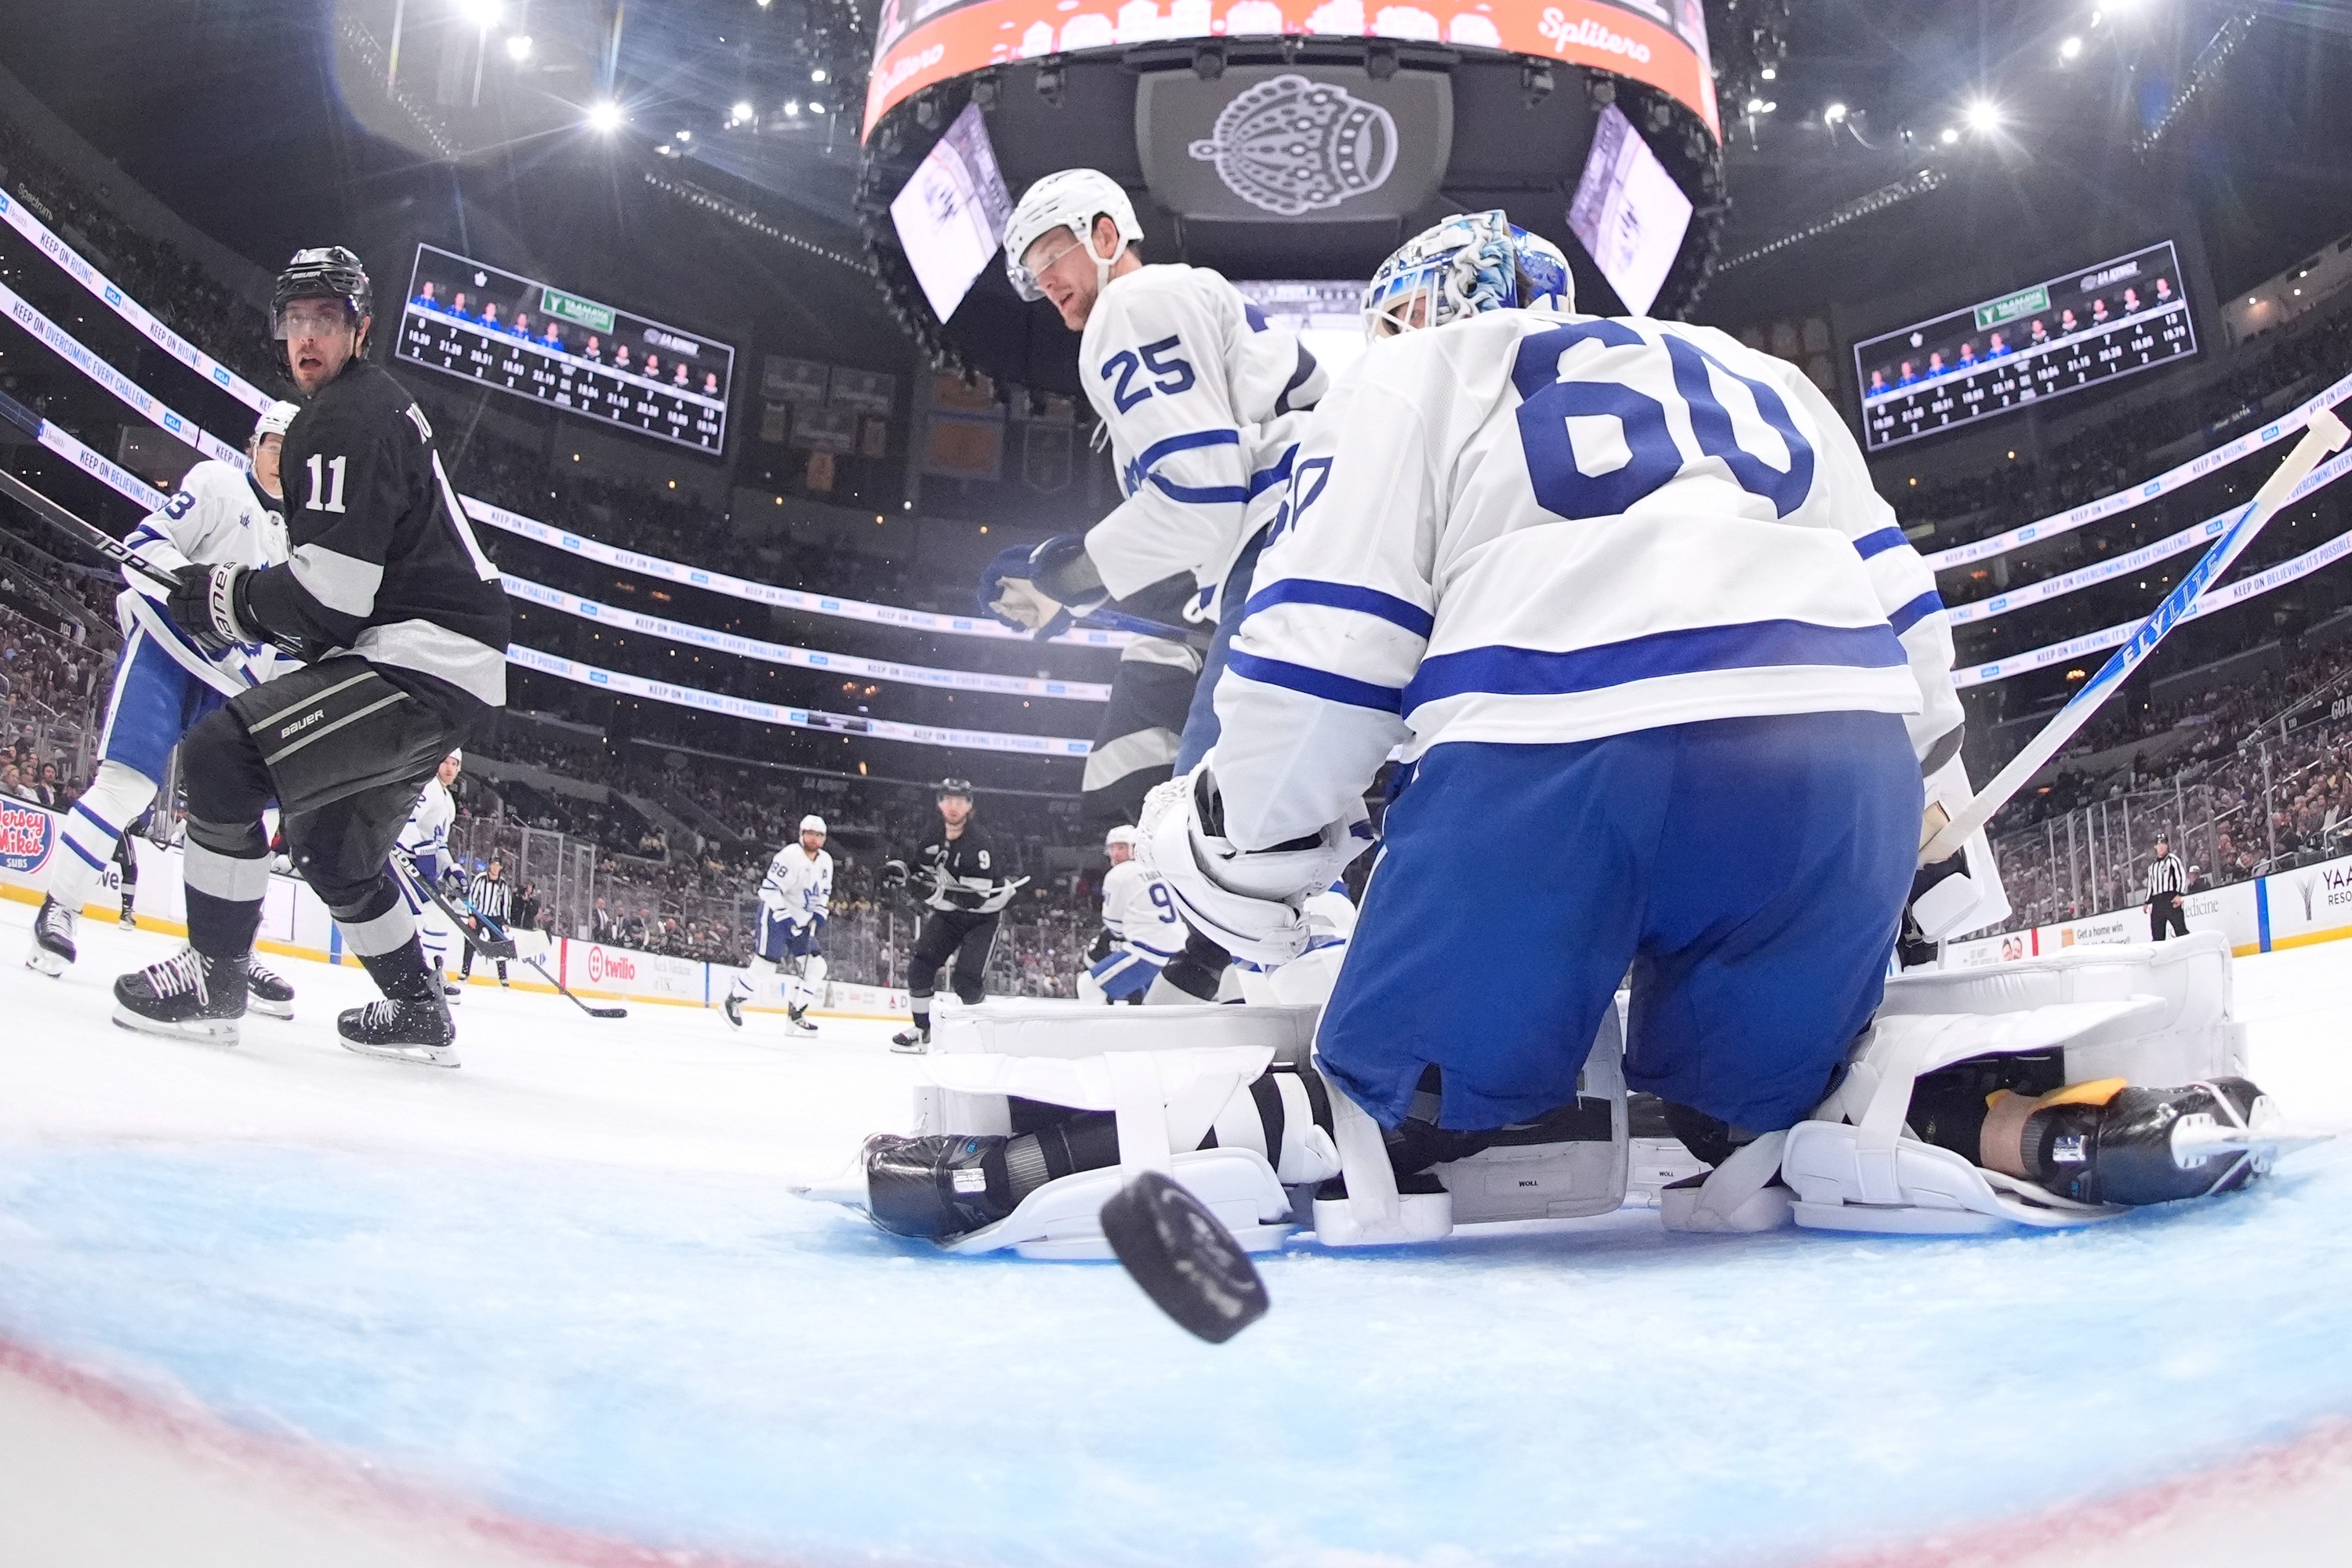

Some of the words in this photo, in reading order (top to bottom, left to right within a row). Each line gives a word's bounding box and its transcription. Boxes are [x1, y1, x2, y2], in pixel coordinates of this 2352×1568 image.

[1538, 7, 1651, 64] Splitero
[18, 183, 53, 221] Spectrum
[40, 231, 60, 253] KEEP
[59, 248, 71, 263] ON
[71, 259, 94, 285] RISING
[150, 322, 166, 341] KEEP
[167, 336, 177, 350] ON
[177, 343, 202, 368] RISING
[13, 301, 33, 323] KEEP
[34, 317, 45, 335] ON
[45, 325, 93, 369] OVERCOMING
[92, 361, 115, 386] EVERY
[115, 378, 153, 413] CHALLENGE
[1101, 335, 1195, 415] 25
[2325, 393, 2336, 405] ON
[164, 413, 181, 432] UCLA
[1495, 318, 1814, 521] 60
[216, 445, 233, 461] KEEP
[2192, 459, 2209, 474] KEEP
[2211, 454, 2221, 465] ON
[80, 449, 99, 470] KEEP
[99, 462, 111, 479] ON
[110, 469, 145, 500] BELIEVING
[145, 490, 159, 509] IT'S
[305, 453, 347, 514] 11
[158, 491, 196, 520] 3
[492, 511, 510, 525] KEEP
[512, 517, 522, 528] ON
[2234, 583, 2252, 598] KEEP
[2254, 578, 2265, 590] ON
[2267, 561, 2306, 583] BELIEVING
[2306, 554, 2319, 568] IT'S
[2320, 537, 2351, 560] POSSIBLE
[502, 577, 521, 592] VERY
[2042, 581, 2061, 593] KEEP
[2063, 578, 2074, 587] ON
[2038, 650, 2055, 662] KEEP
[2057, 645, 2068, 657] ON
[649, 683, 669, 696] KEEP
[671, 687, 682, 699] ON
[281, 709, 325, 739] BAUER
[6, 858, 27, 869] SUBS
[978, 850, 990, 869] 9
[2183, 899, 2219, 918] edicine
[2077, 929, 2087, 939] Get
[2093, 926, 2111, 936] home
[2111, 921, 2123, 932] win
[604, 956, 635, 980] twilio
